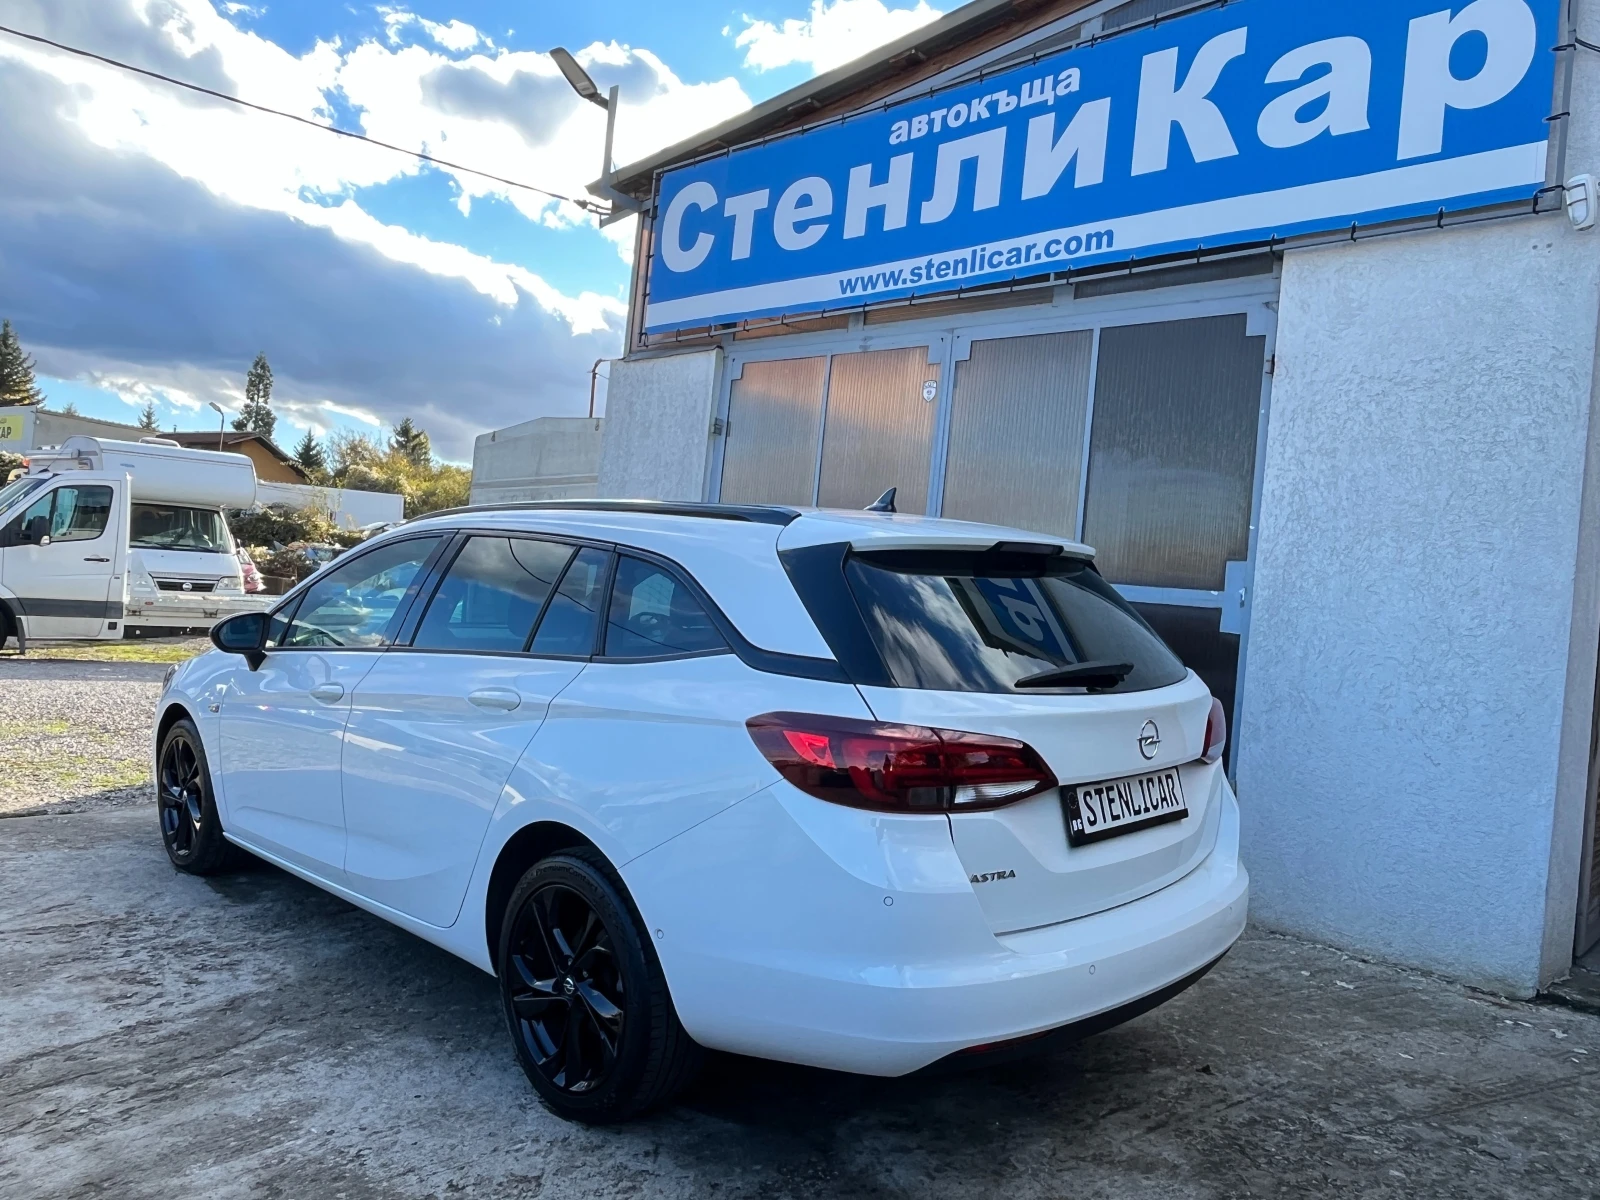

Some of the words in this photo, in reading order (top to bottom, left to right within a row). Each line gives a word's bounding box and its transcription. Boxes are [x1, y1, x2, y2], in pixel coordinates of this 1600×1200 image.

[889, 66, 1081, 146] автокъща
[839, 226, 1114, 296] www.stenlicar.com
[1082, 773, 1179, 827] STENLICAR
[970, 869, 1016, 883] ASTRA
